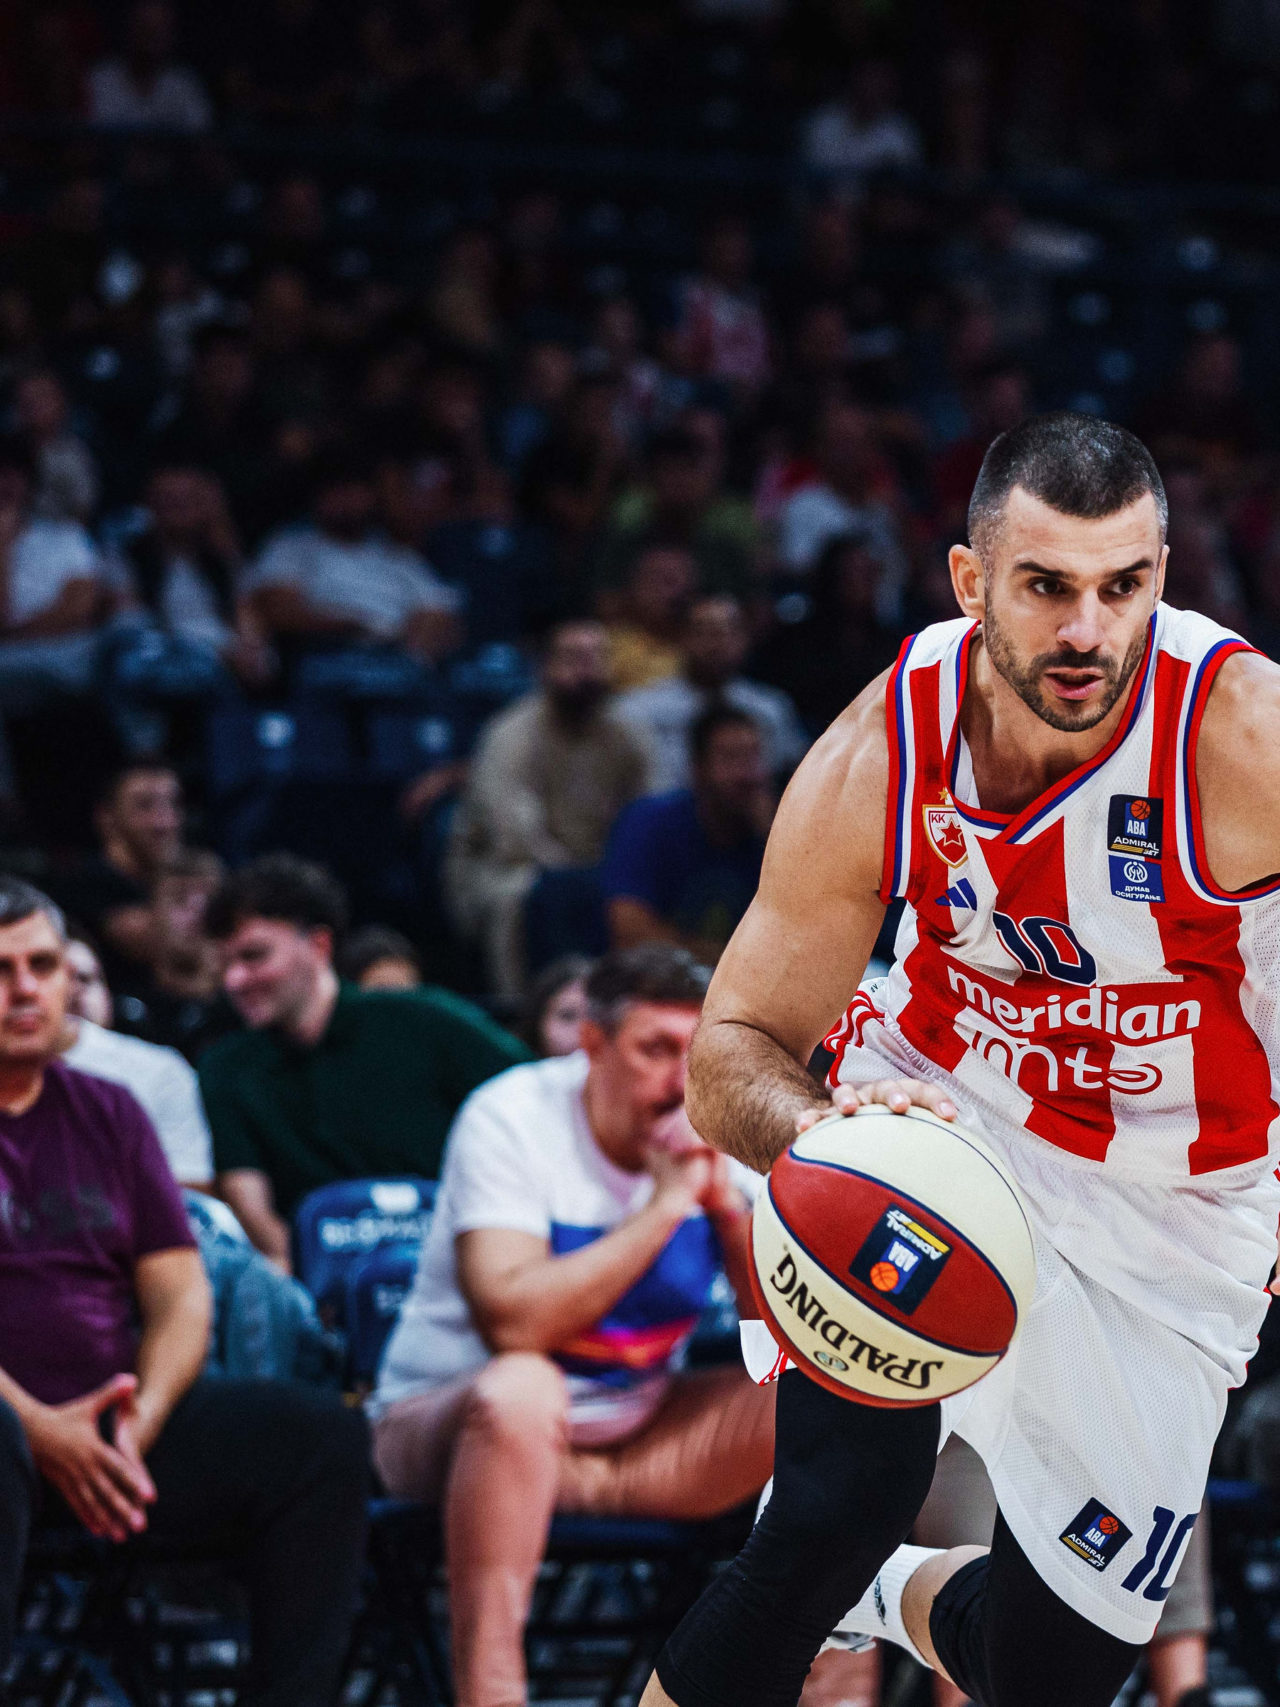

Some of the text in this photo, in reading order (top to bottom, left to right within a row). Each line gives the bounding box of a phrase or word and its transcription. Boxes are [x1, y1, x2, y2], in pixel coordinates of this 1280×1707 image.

[931, 813, 946, 824] KK
[1126, 819, 1147, 837] ABA
[1113, 836, 1160, 852] ADMIRAL
[992, 911, 1098, 987] 10
[946, 965, 1202, 1040] meridian
[970, 1030, 1164, 1096] mts
[886, 1213, 944, 1260] ADMIRAL
[770, 1253, 944, 1389] SPALDING
[1067, 1533, 1106, 1566] ADMIRAL
[1084, 1527, 1106, 1548] ABA
